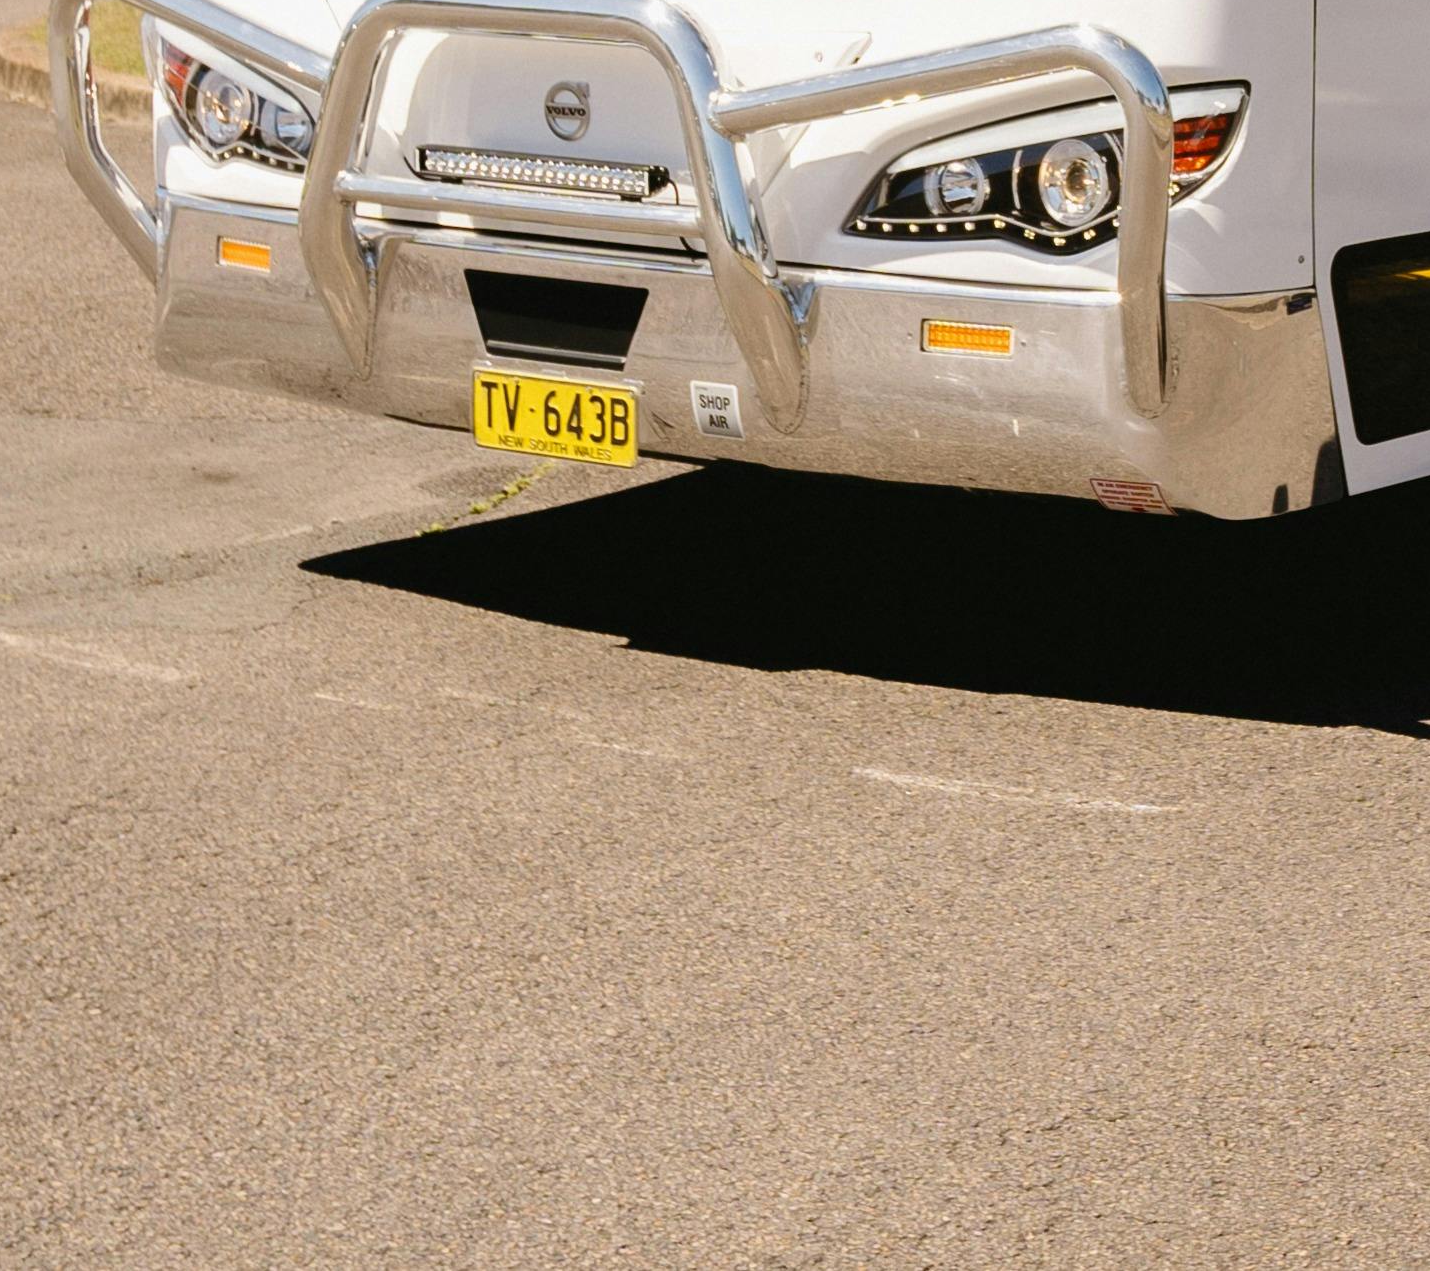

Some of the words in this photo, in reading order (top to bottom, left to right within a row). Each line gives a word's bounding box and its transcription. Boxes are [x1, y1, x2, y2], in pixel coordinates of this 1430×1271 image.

[546, 104, 586, 117] VOLVO
[699, 394, 731, 411] SHOP
[709, 414, 730, 429] AIR
[498, 435, 524, 449] NEW
[530, 439, 568, 454] SOUTH
[574, 446, 612, 461] WALES
